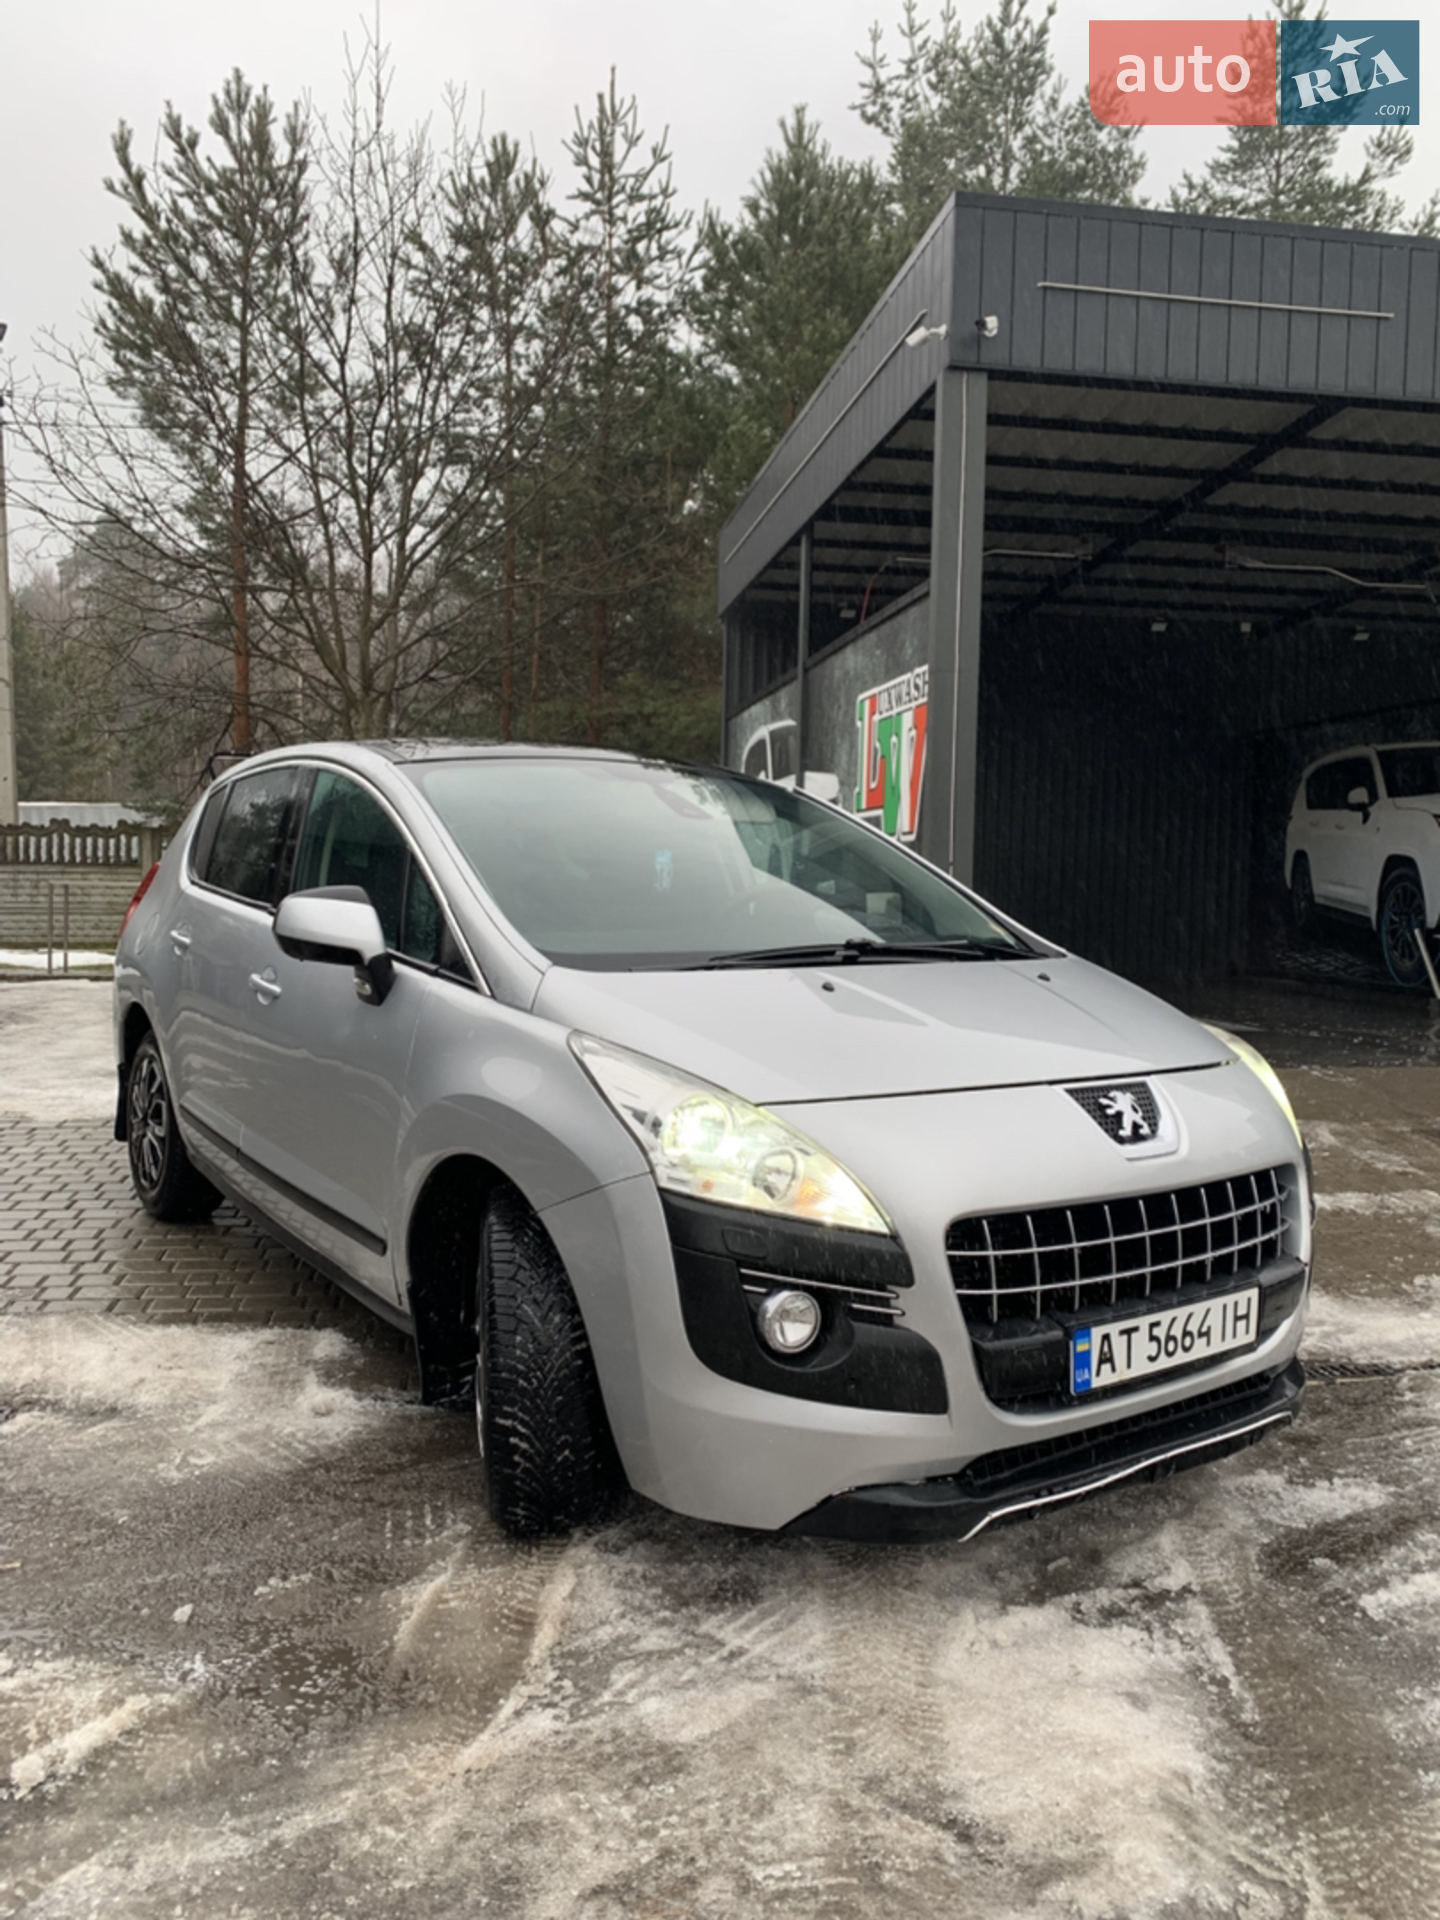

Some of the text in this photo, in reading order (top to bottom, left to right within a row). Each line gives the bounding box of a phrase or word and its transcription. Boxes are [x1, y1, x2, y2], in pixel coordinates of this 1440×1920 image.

[1096, 1297, 1251, 1378] AT 5664 IH
[1075, 1367, 1090, 1383] UA
